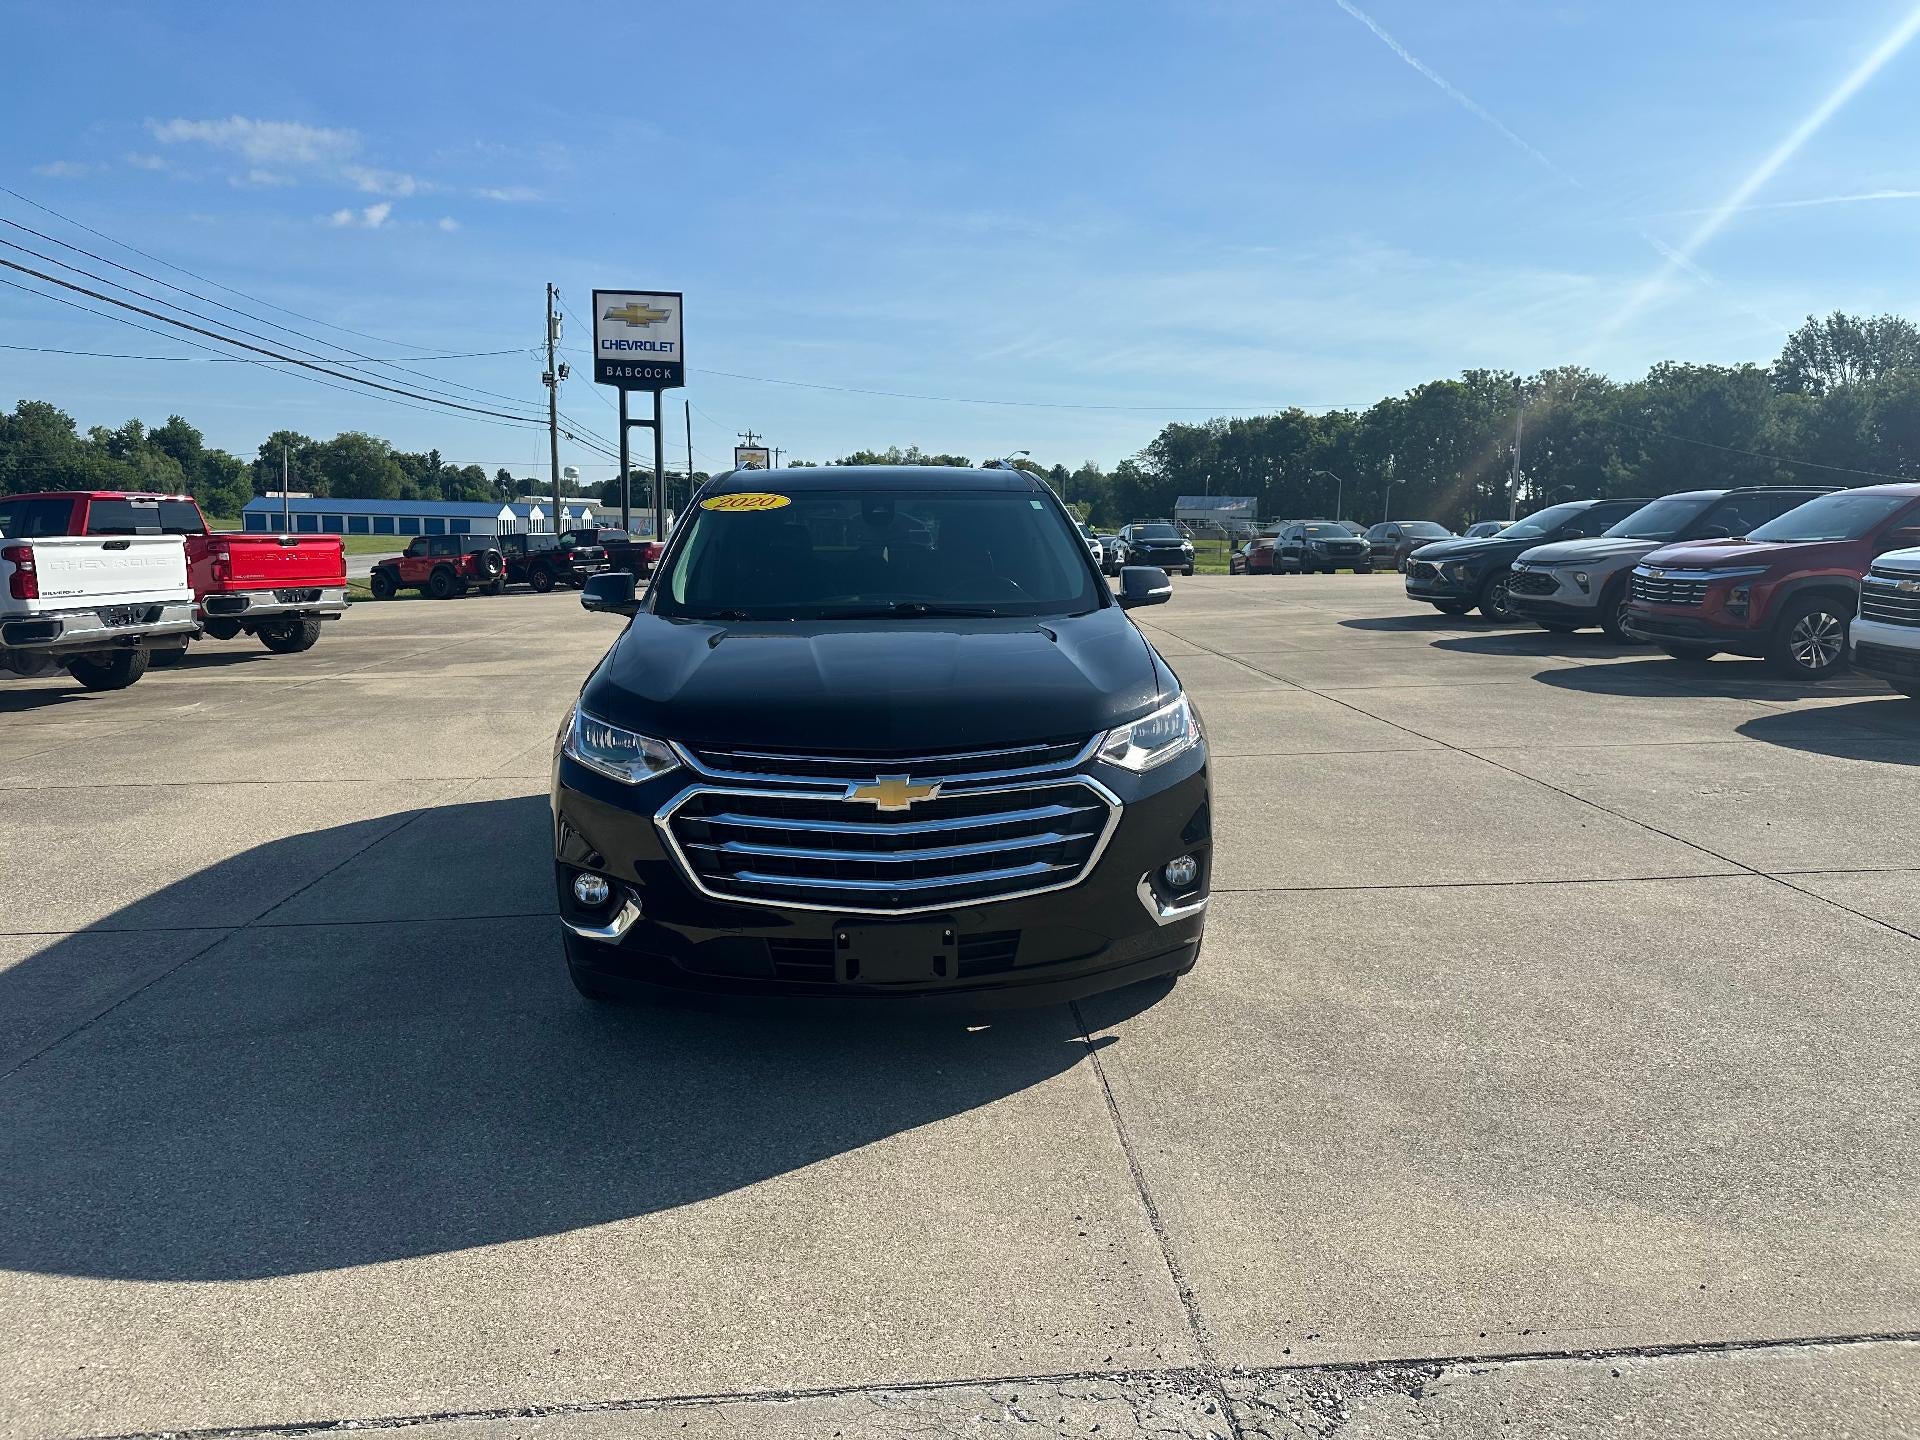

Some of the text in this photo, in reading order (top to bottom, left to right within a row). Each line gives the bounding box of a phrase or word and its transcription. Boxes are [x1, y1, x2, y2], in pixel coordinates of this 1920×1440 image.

[601, 339, 675, 353] CHEVROLET
[606, 366, 672, 379] BABCOCK
[712, 496, 777, 509] 2020
[48, 557, 177, 571] CHEVROLET
